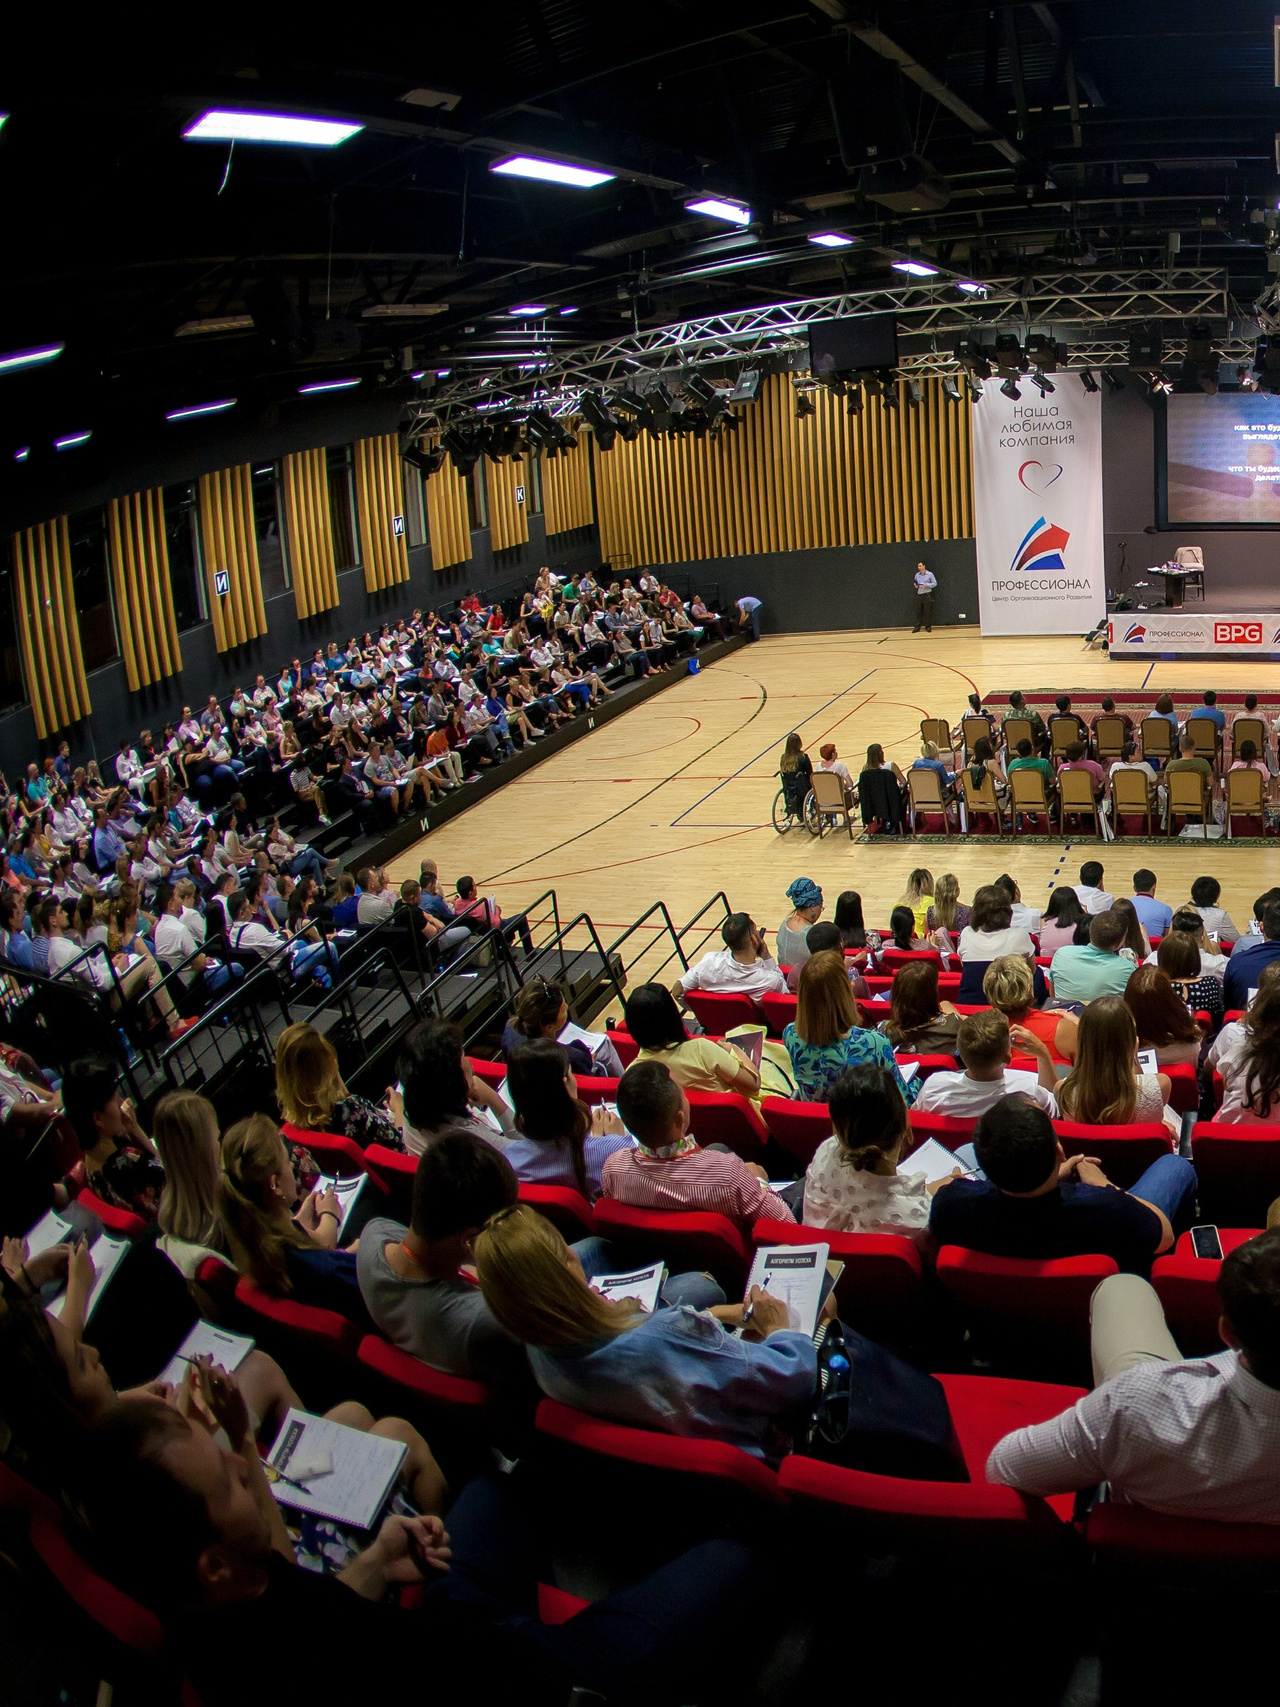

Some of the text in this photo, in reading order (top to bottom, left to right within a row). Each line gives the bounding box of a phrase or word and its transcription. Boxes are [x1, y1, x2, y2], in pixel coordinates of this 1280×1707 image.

[1013, 406, 1059, 418] Наша
[1001, 419, 1072, 434] любимая
[999, 434, 1075, 448] компания
[991, 579, 1091, 591] ПРОФЕССИОНАЛ
[1149, 630, 1205, 638] ПРОФЕССИОНАЛ
[1216, 625, 1260, 642] BPG
[587, 717, 595, 729] И
[420, 817, 430, 832] И
